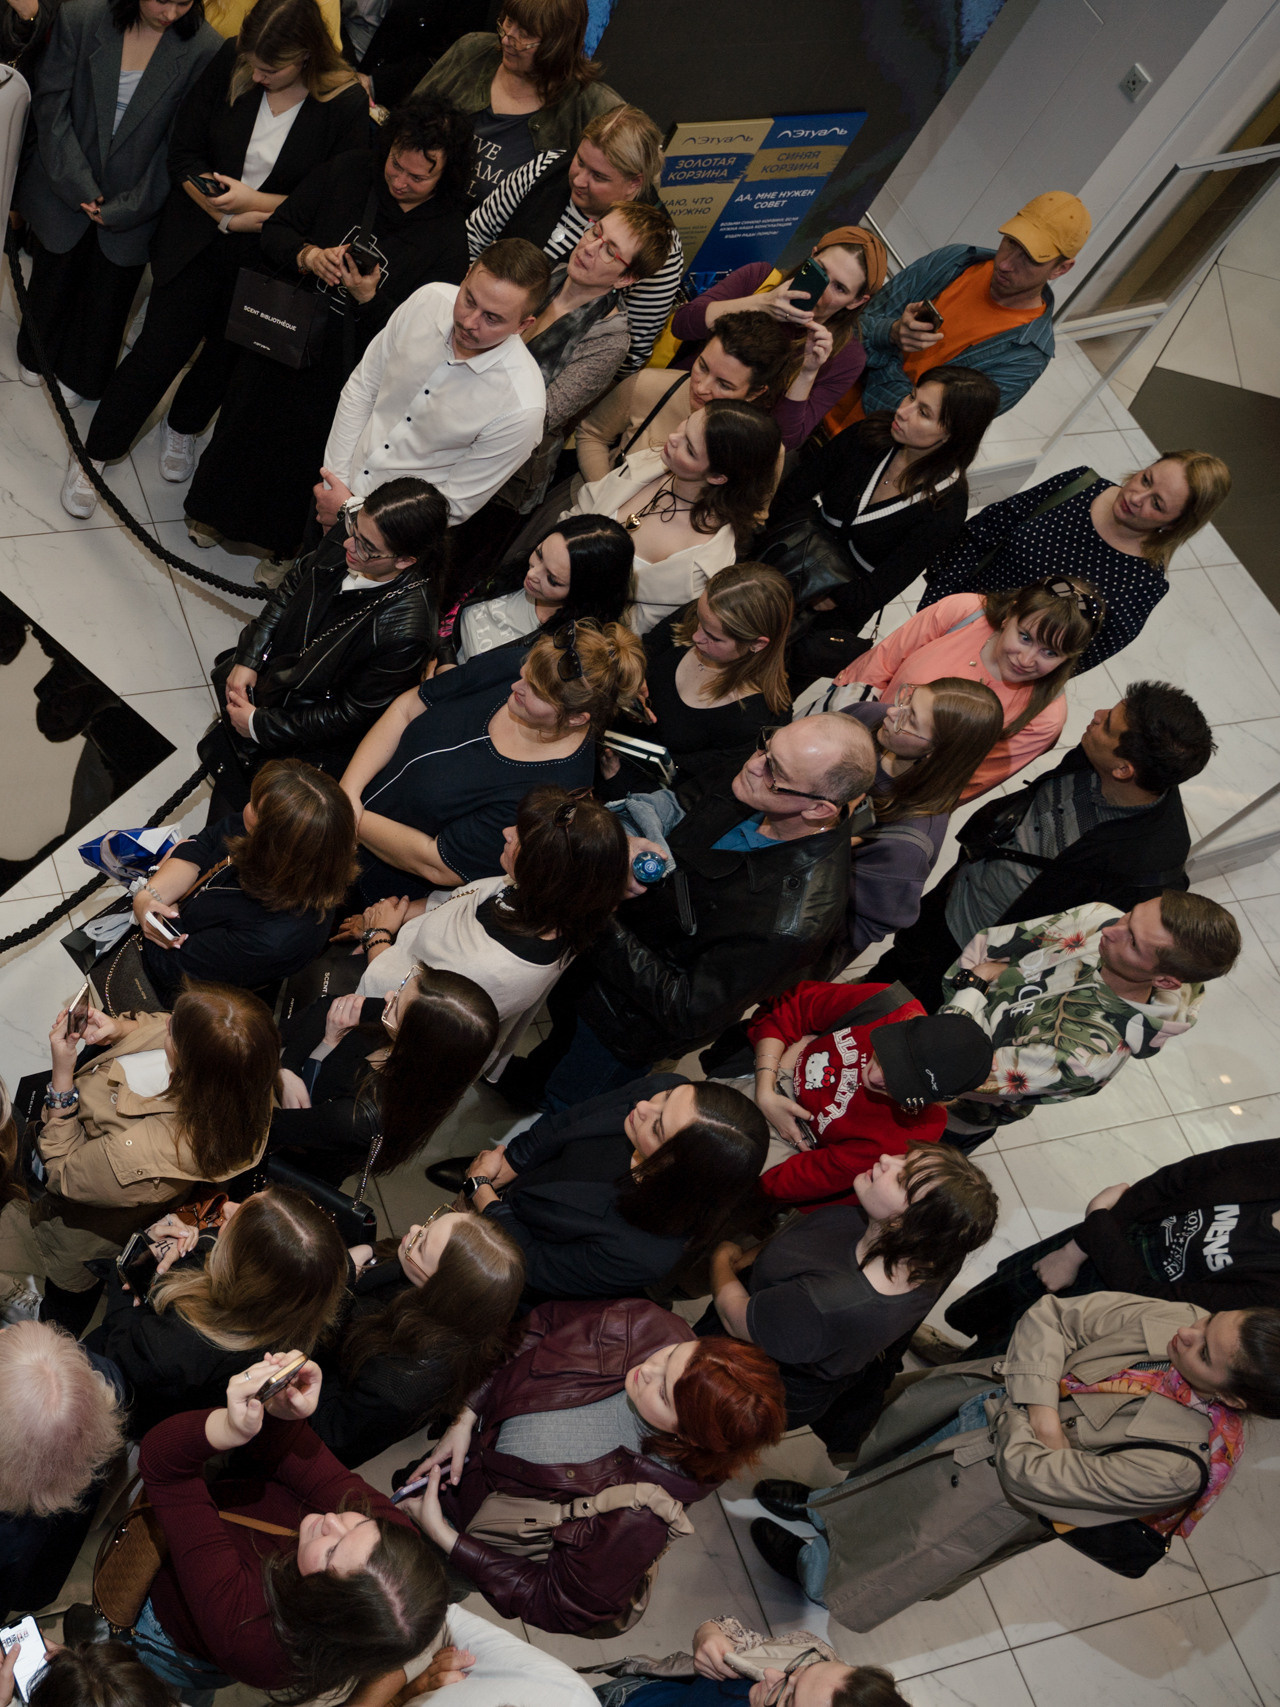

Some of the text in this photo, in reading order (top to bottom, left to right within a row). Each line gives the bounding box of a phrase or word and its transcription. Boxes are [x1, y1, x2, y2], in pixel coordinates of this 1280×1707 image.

[675, 156, 737, 169] ЗОЛОТАЯ
[777, 151, 821, 162] СИНЯЯ
[761, 162, 820, 174] КОРЗИНА
[668, 168, 729, 181] КОРЗИНА
[692, 196, 714, 205] ЧТО
[734, 188, 816, 203] ДА, МНЕ НУЖЕН
[753, 199, 788, 209] СОВЕТ
[670, 207, 711, 216] НУЖНО
[1202, 1204, 1240, 1272] MENS
